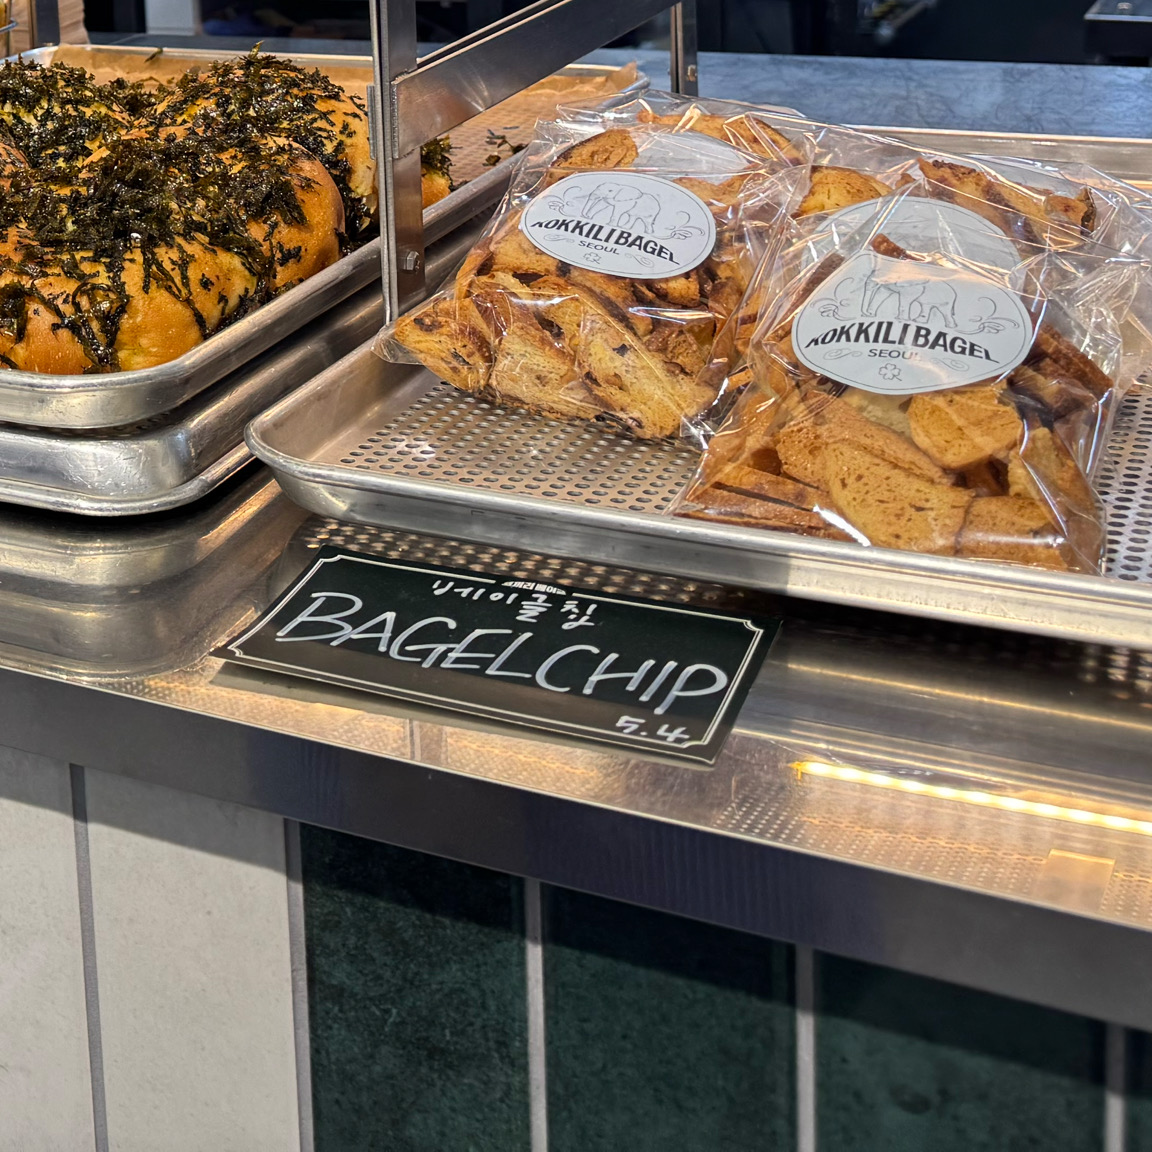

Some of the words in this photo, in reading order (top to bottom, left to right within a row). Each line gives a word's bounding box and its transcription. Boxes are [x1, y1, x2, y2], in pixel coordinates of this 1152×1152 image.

[578, 239, 620, 255] SEOUL
[614, 230, 680, 266] BAGEL
[911, 325, 1000, 364] BAGEL
[615, 715, 690, 743] 5.4
